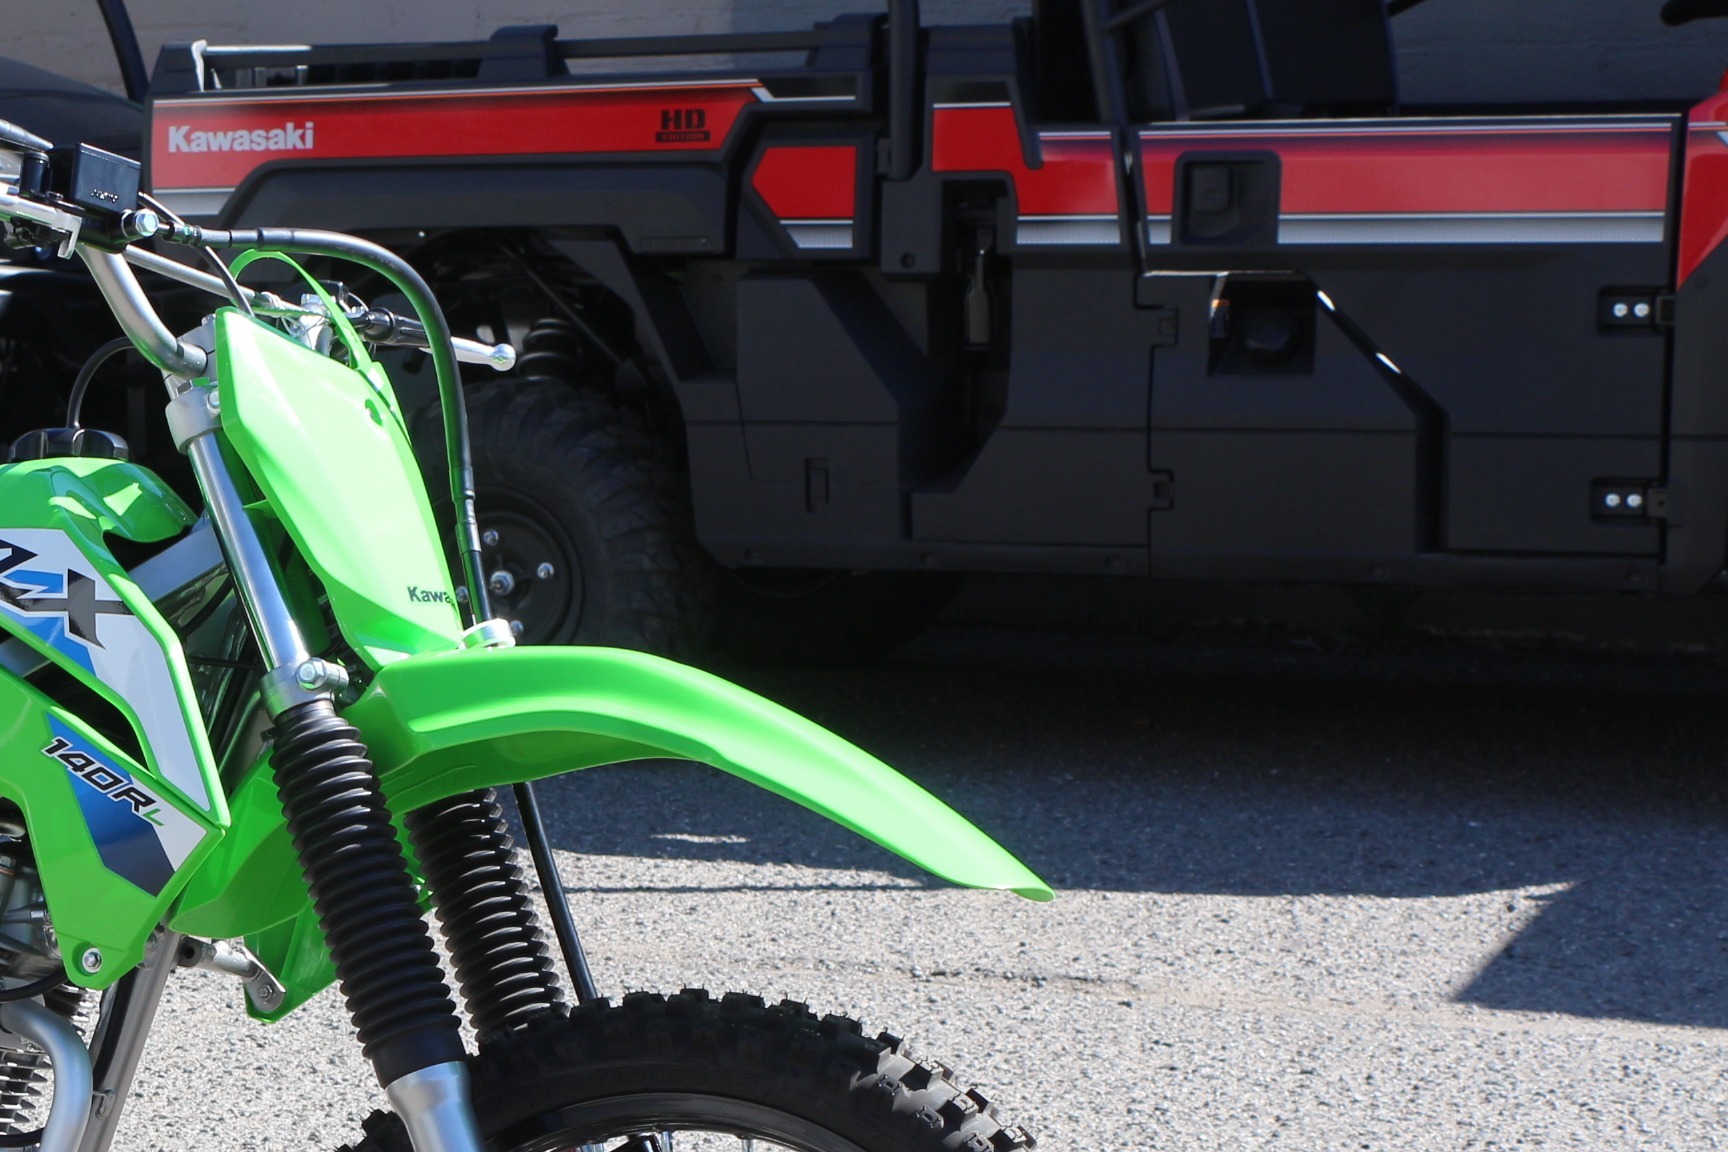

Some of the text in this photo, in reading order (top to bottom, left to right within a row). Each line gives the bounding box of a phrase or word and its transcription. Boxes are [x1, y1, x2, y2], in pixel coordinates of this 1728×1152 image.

[661, 109, 706, 130] HD
[168, 121, 314, 153] Kawasaki
[407, 586, 454, 607] Kawa
